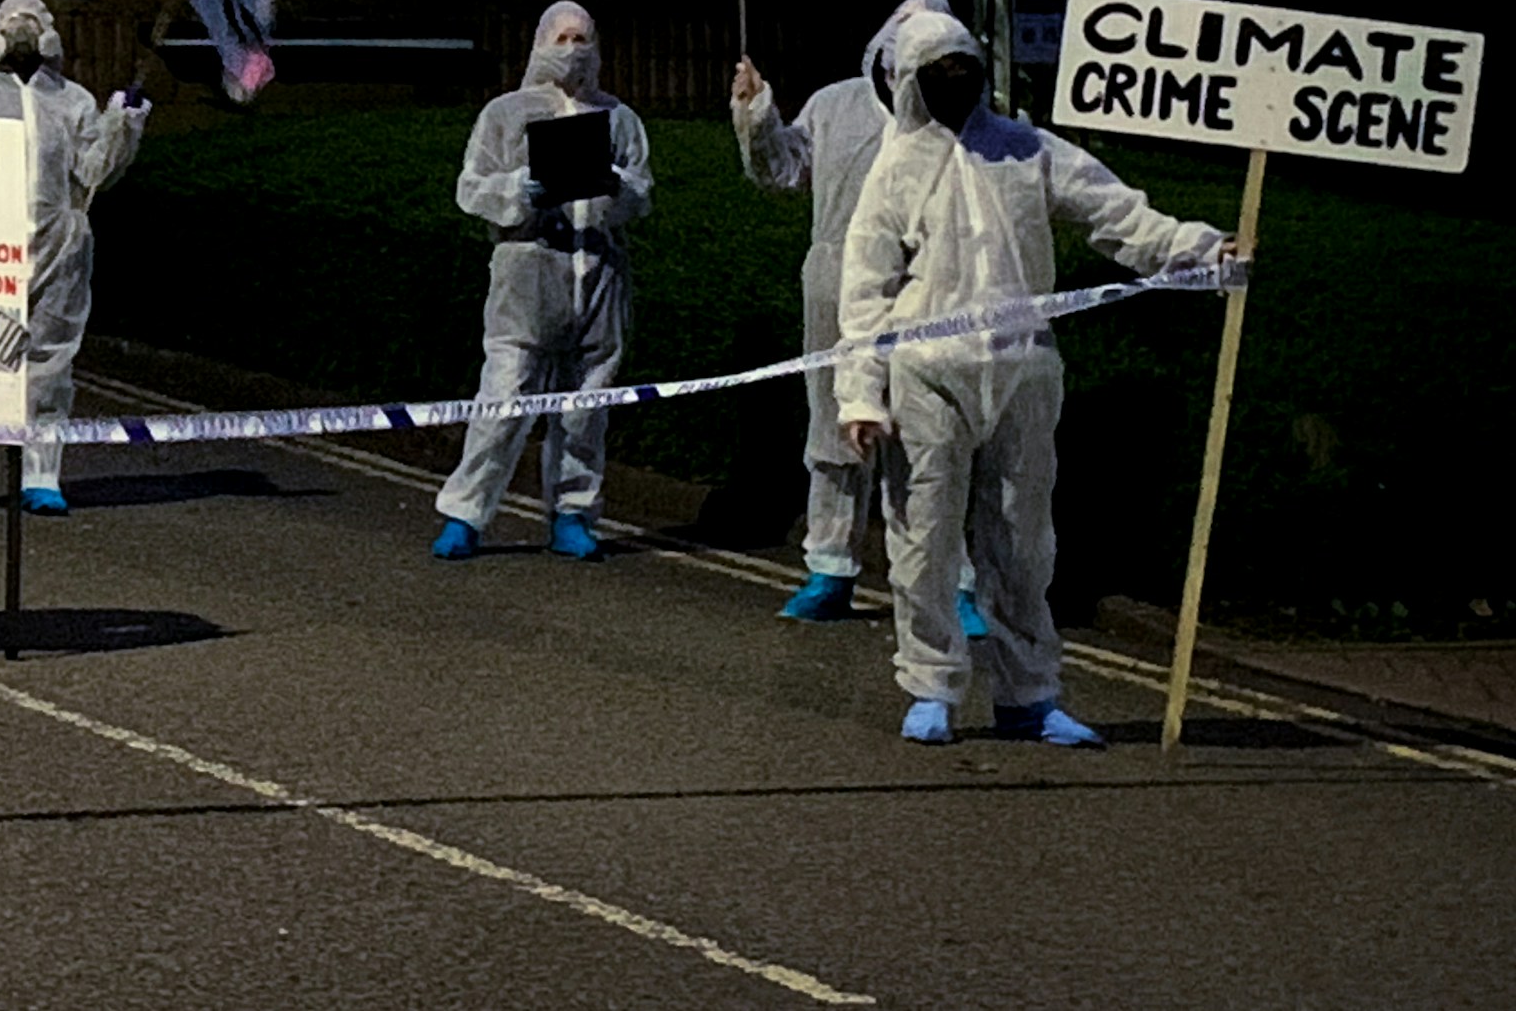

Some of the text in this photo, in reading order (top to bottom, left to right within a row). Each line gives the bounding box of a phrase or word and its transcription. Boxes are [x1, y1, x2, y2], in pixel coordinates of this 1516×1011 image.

[1082, 1, 1467, 95] CLIMATE
[1070, 61, 1457, 156] CRIME SCENE
